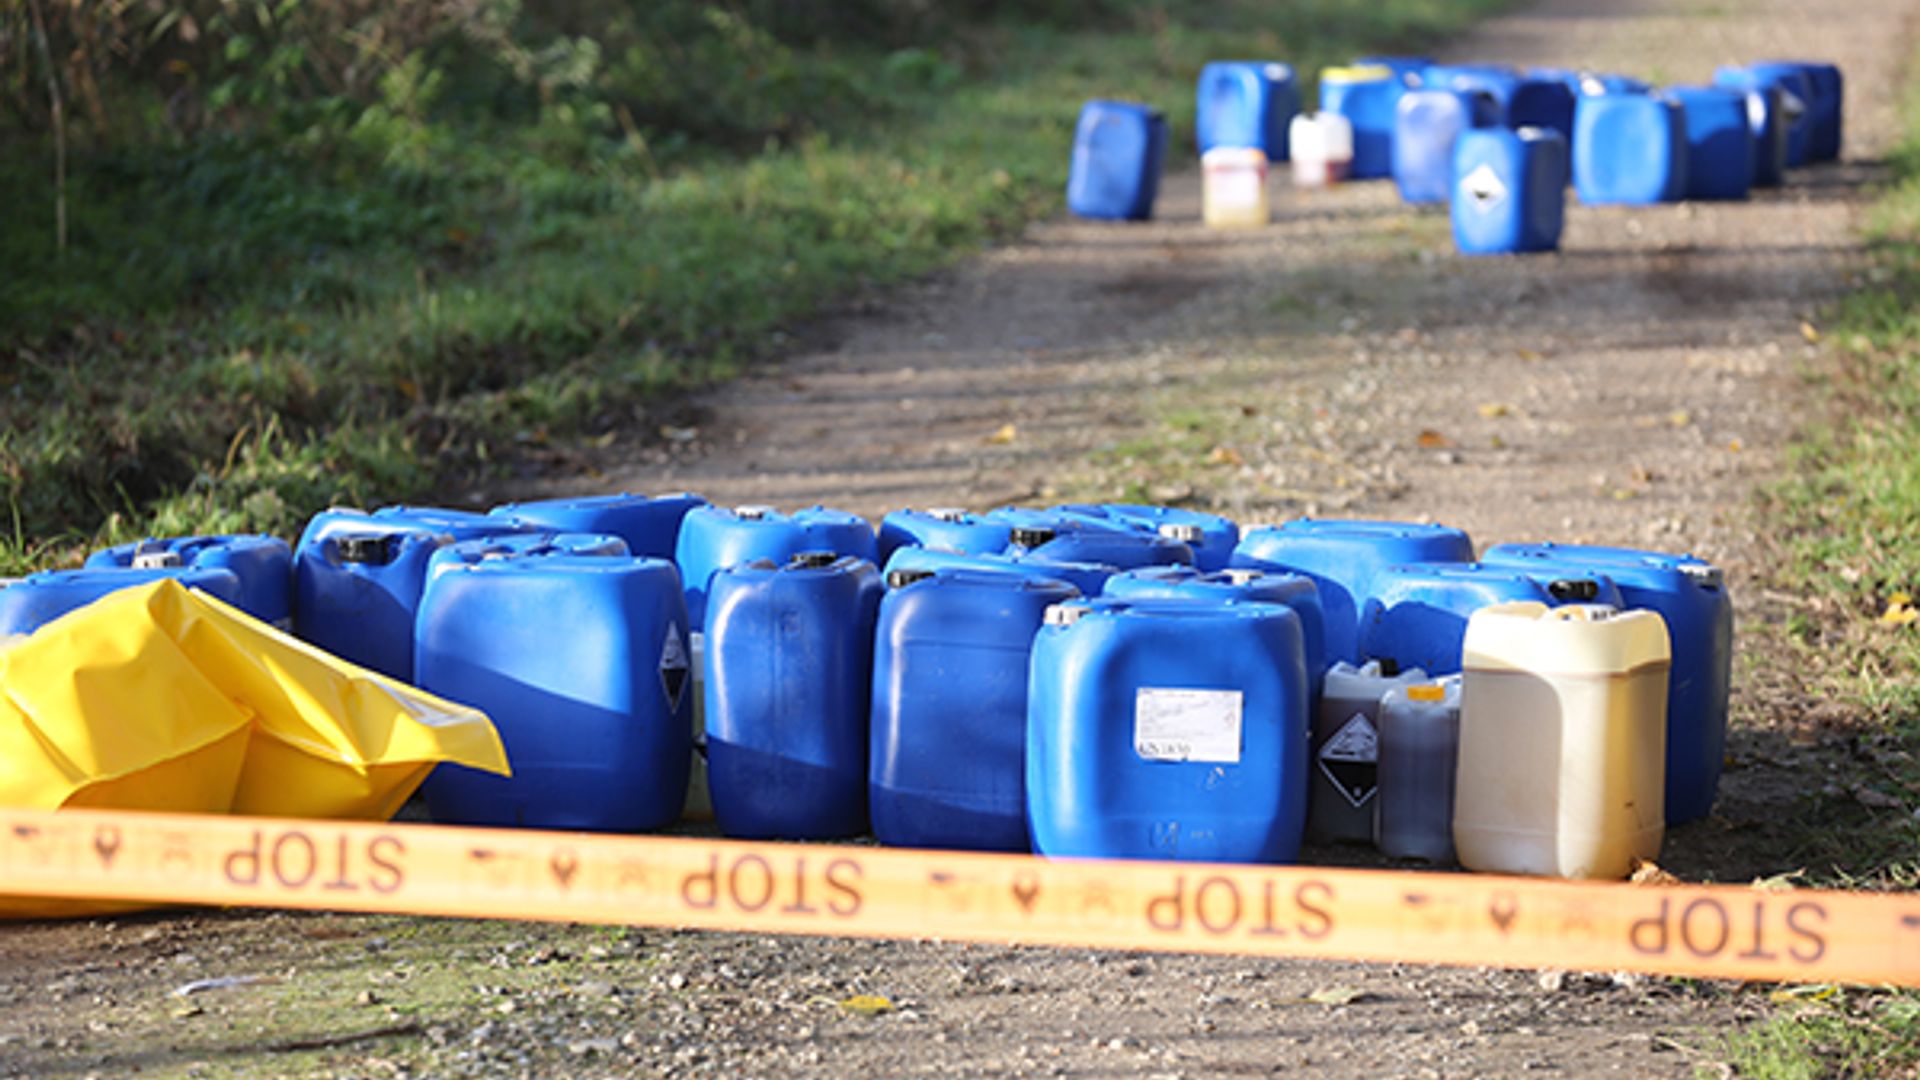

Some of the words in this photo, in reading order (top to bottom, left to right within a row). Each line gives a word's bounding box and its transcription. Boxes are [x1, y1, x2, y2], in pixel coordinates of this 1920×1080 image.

[223, 831, 406, 893] STOP
[681, 853, 864, 917] STOP
[1146, 875, 1335, 940] STOP
[1629, 897, 1827, 964] STOP
